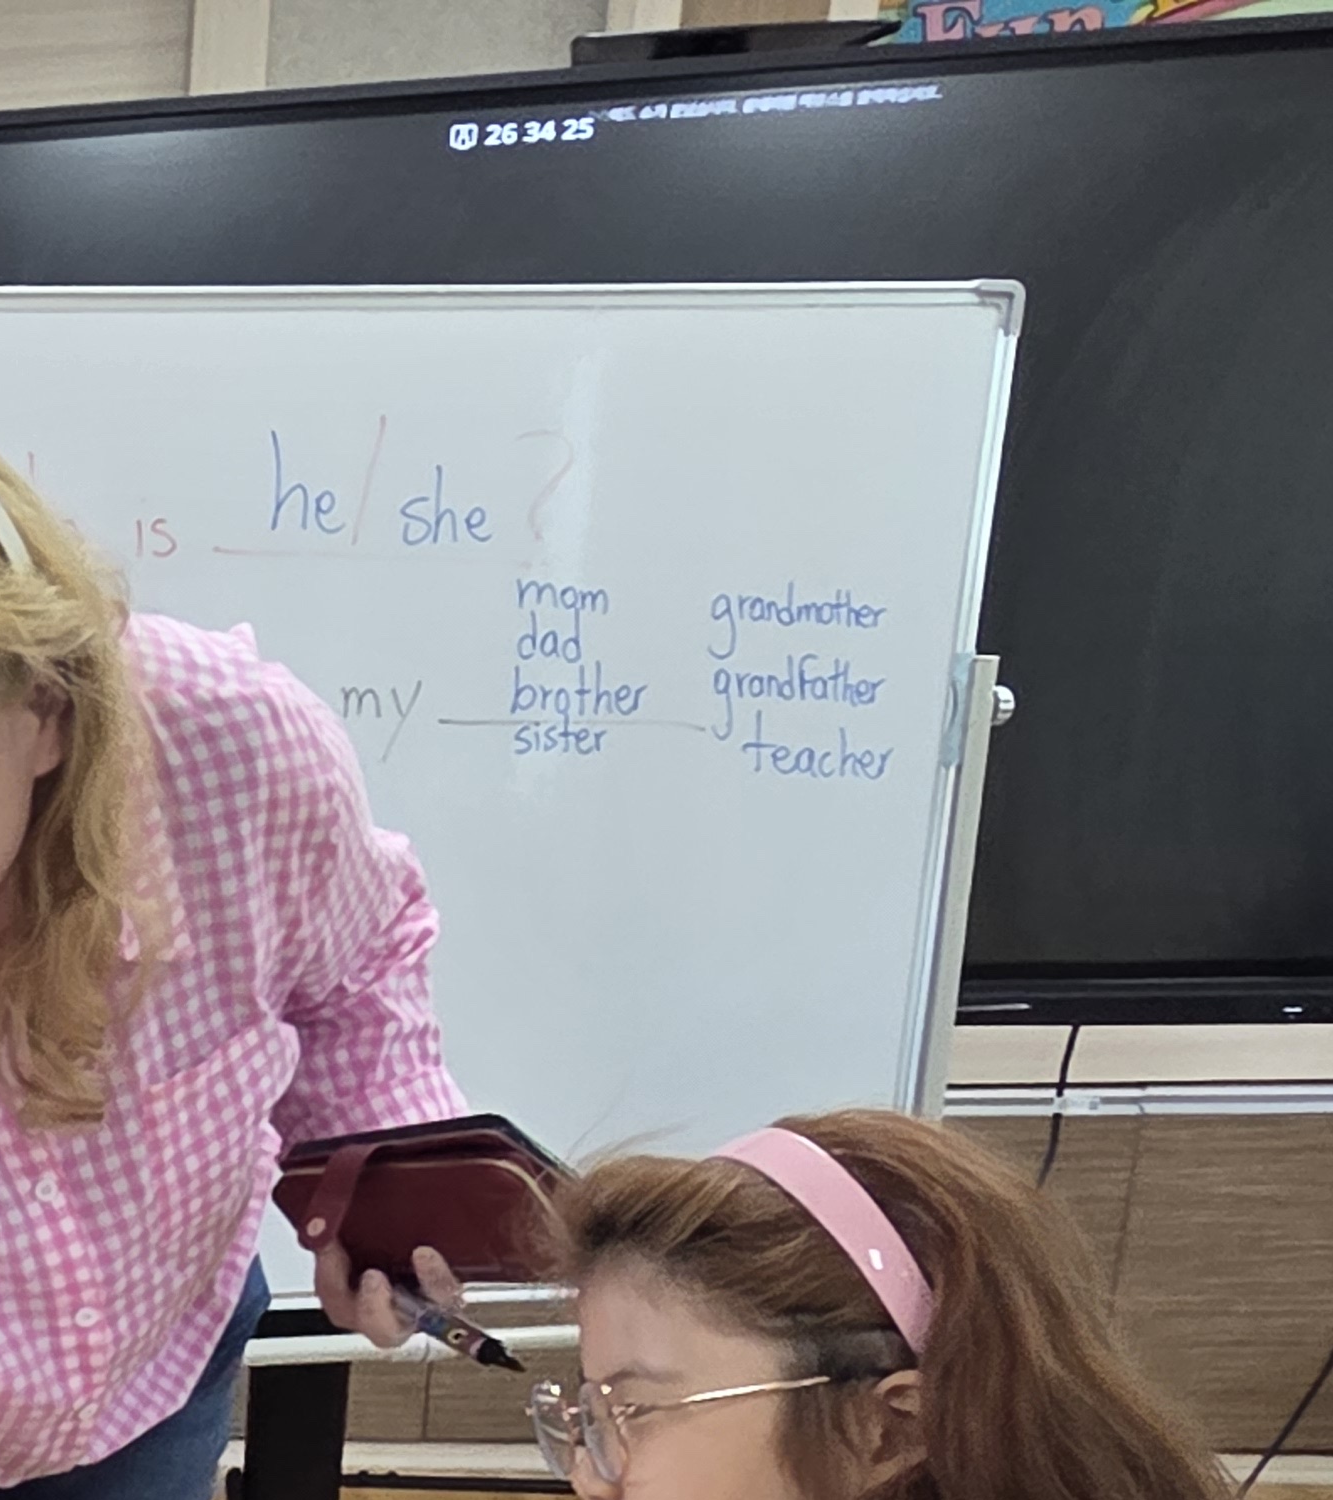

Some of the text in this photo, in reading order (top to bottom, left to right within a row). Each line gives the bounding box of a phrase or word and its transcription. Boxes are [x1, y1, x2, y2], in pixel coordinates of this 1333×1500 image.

[483, 117, 595, 146] 26 34 25
[516, 577, 609, 615] mom
[708, 580, 887, 660] grandmother
[516, 610, 582, 663] dad
[510, 660, 648, 716] brother
[341, 679, 423, 763] my
[514, 718, 608, 755] sister
[742, 709, 894, 780] teacher
